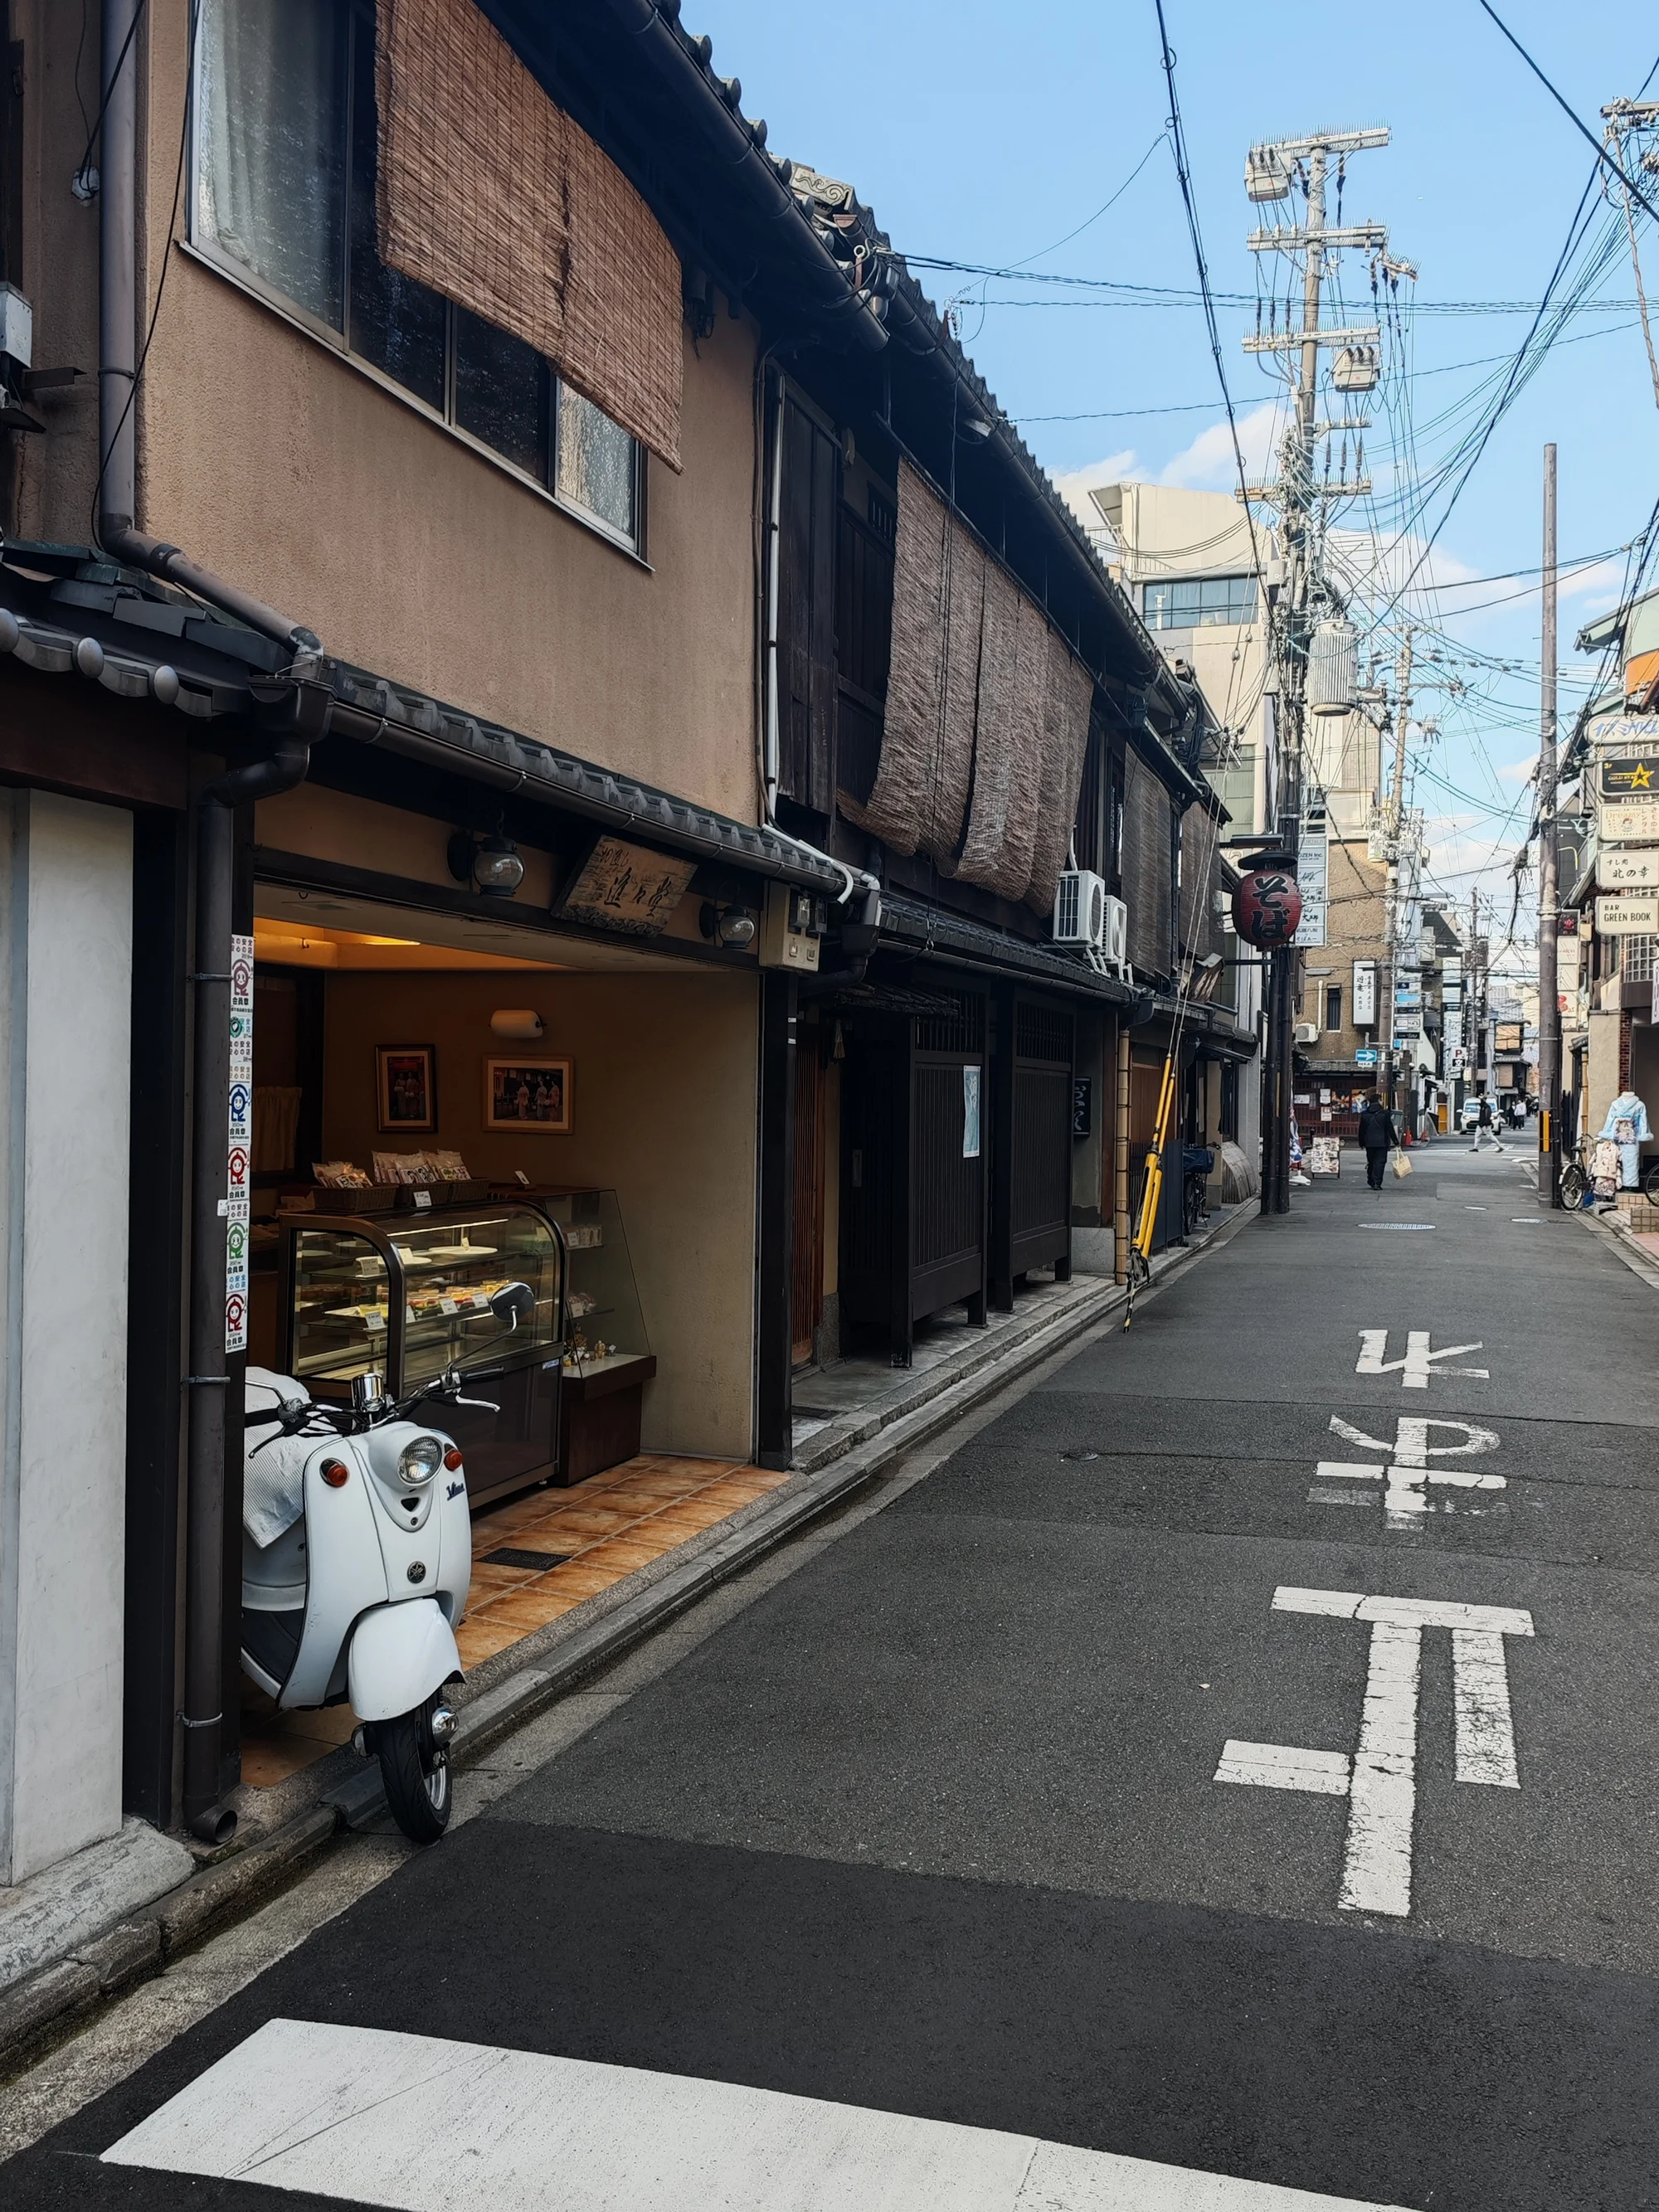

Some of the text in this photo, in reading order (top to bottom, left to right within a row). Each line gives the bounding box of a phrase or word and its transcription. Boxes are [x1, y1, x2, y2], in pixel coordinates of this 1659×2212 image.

[1613, 866, 1650, 879] 北の幸
[1251, 874, 1291, 941] そば
[1603, 912, 1652, 922] GREEN BOOK
[1455, 1049, 1462, 1057] P
